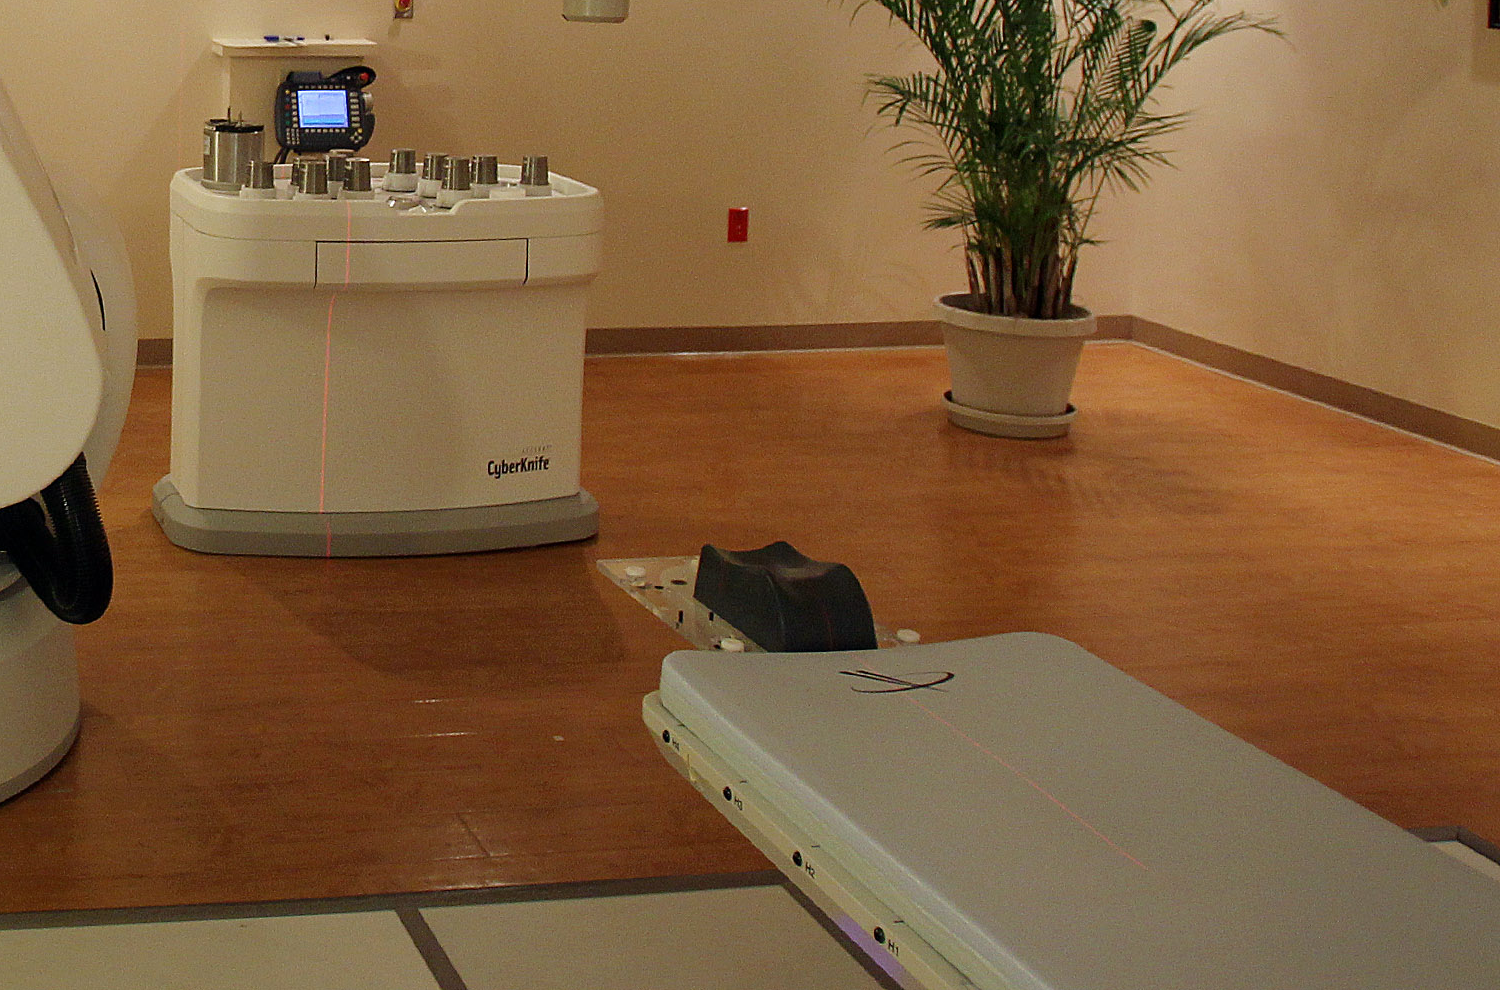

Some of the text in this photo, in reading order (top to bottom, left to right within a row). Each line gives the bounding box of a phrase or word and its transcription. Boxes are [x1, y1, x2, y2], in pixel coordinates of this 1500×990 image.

[487, 456, 549, 479] CyberKnife
[805, 861, 815, 880] H2
[888, 938, 899, 958] H1
